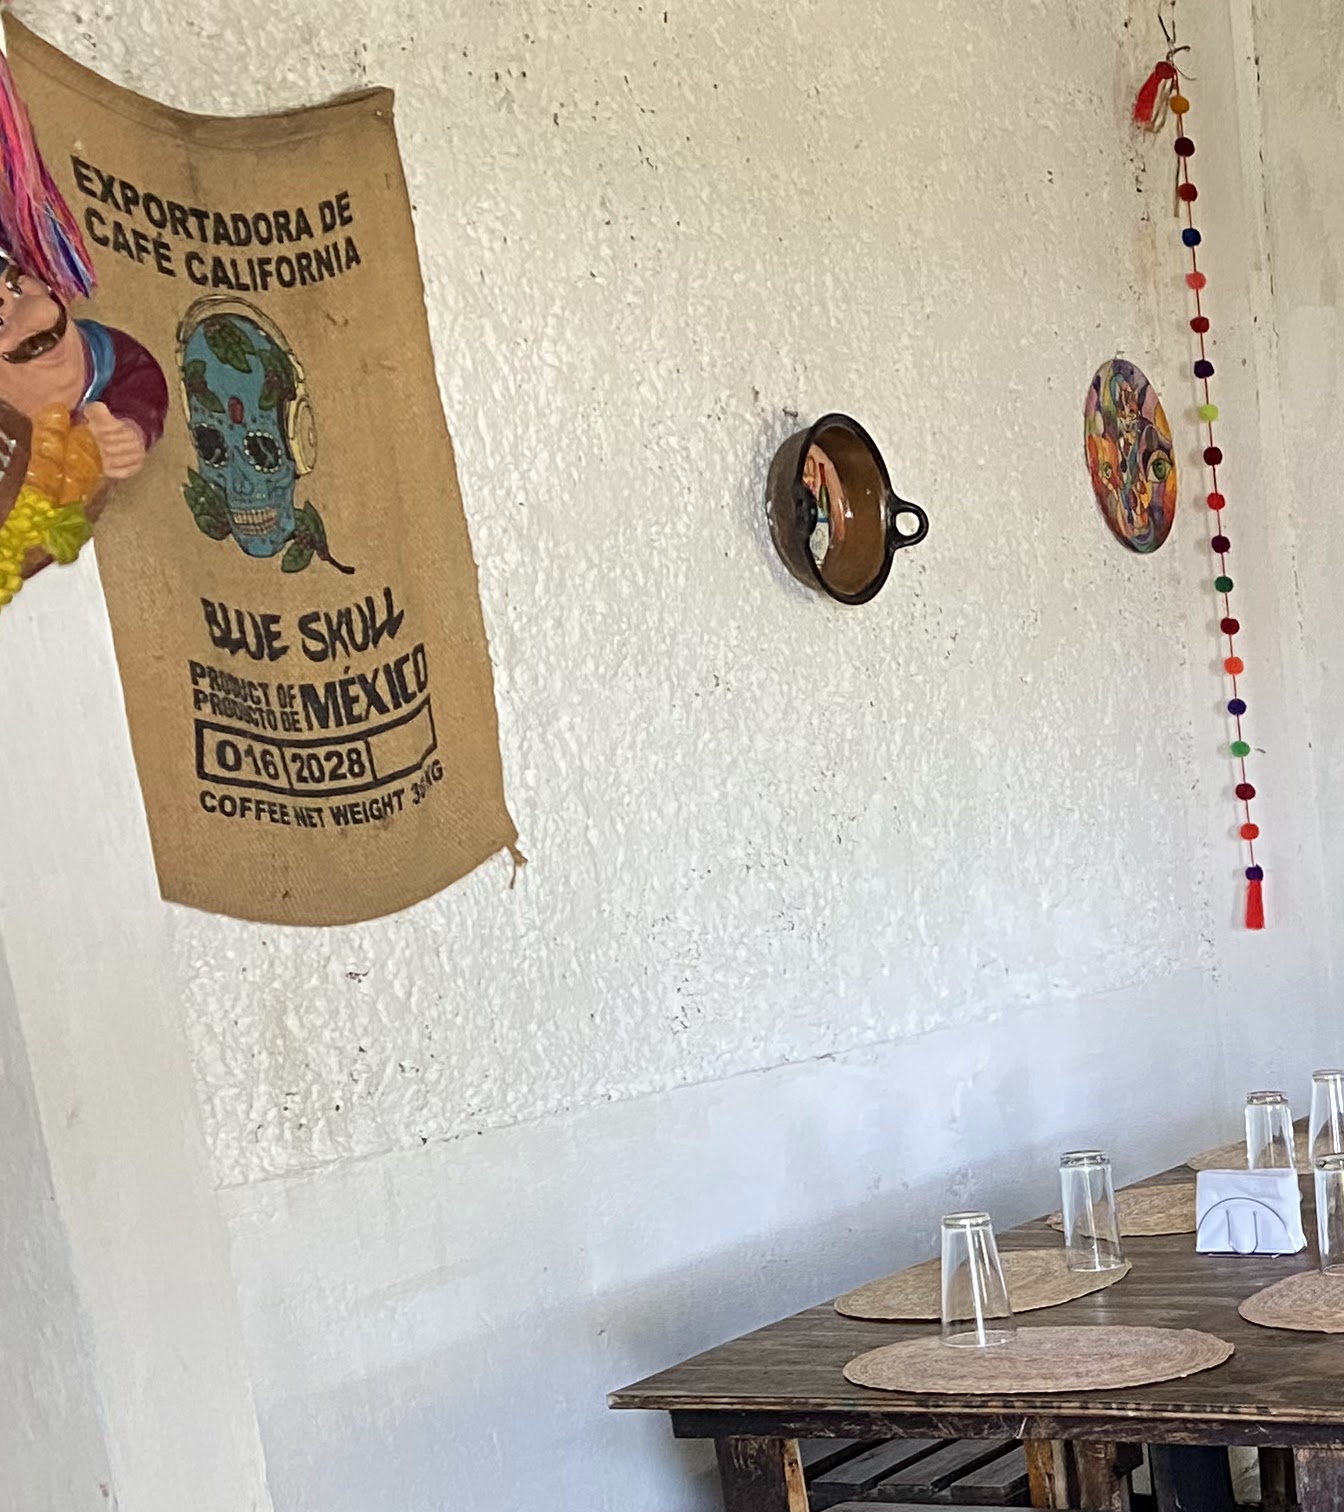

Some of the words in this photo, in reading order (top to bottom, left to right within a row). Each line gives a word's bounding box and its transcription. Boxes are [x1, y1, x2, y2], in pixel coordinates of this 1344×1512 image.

[71, 154, 313, 247] EXPORTADORA
[319, 190, 353, 233] DE
[84, 207, 176, 277] CAFÉ
[185, 236, 361, 292] CALIFORNIA
[201, 597, 290, 662] BLUE
[298, 586, 404, 662] SKULL
[188, 660, 271, 707] PRODUCT
[276, 683, 296, 709] OF
[298, 643, 428, 731] MÉXICO
[280, 710, 302, 732] DE
[215, 740, 280, 781] 016
[291, 747, 366, 784] 2028
[200, 790, 291, 826] COFFEE
[293, 807, 324, 828] NET
[330, 788, 405, 828] WEIGHT
